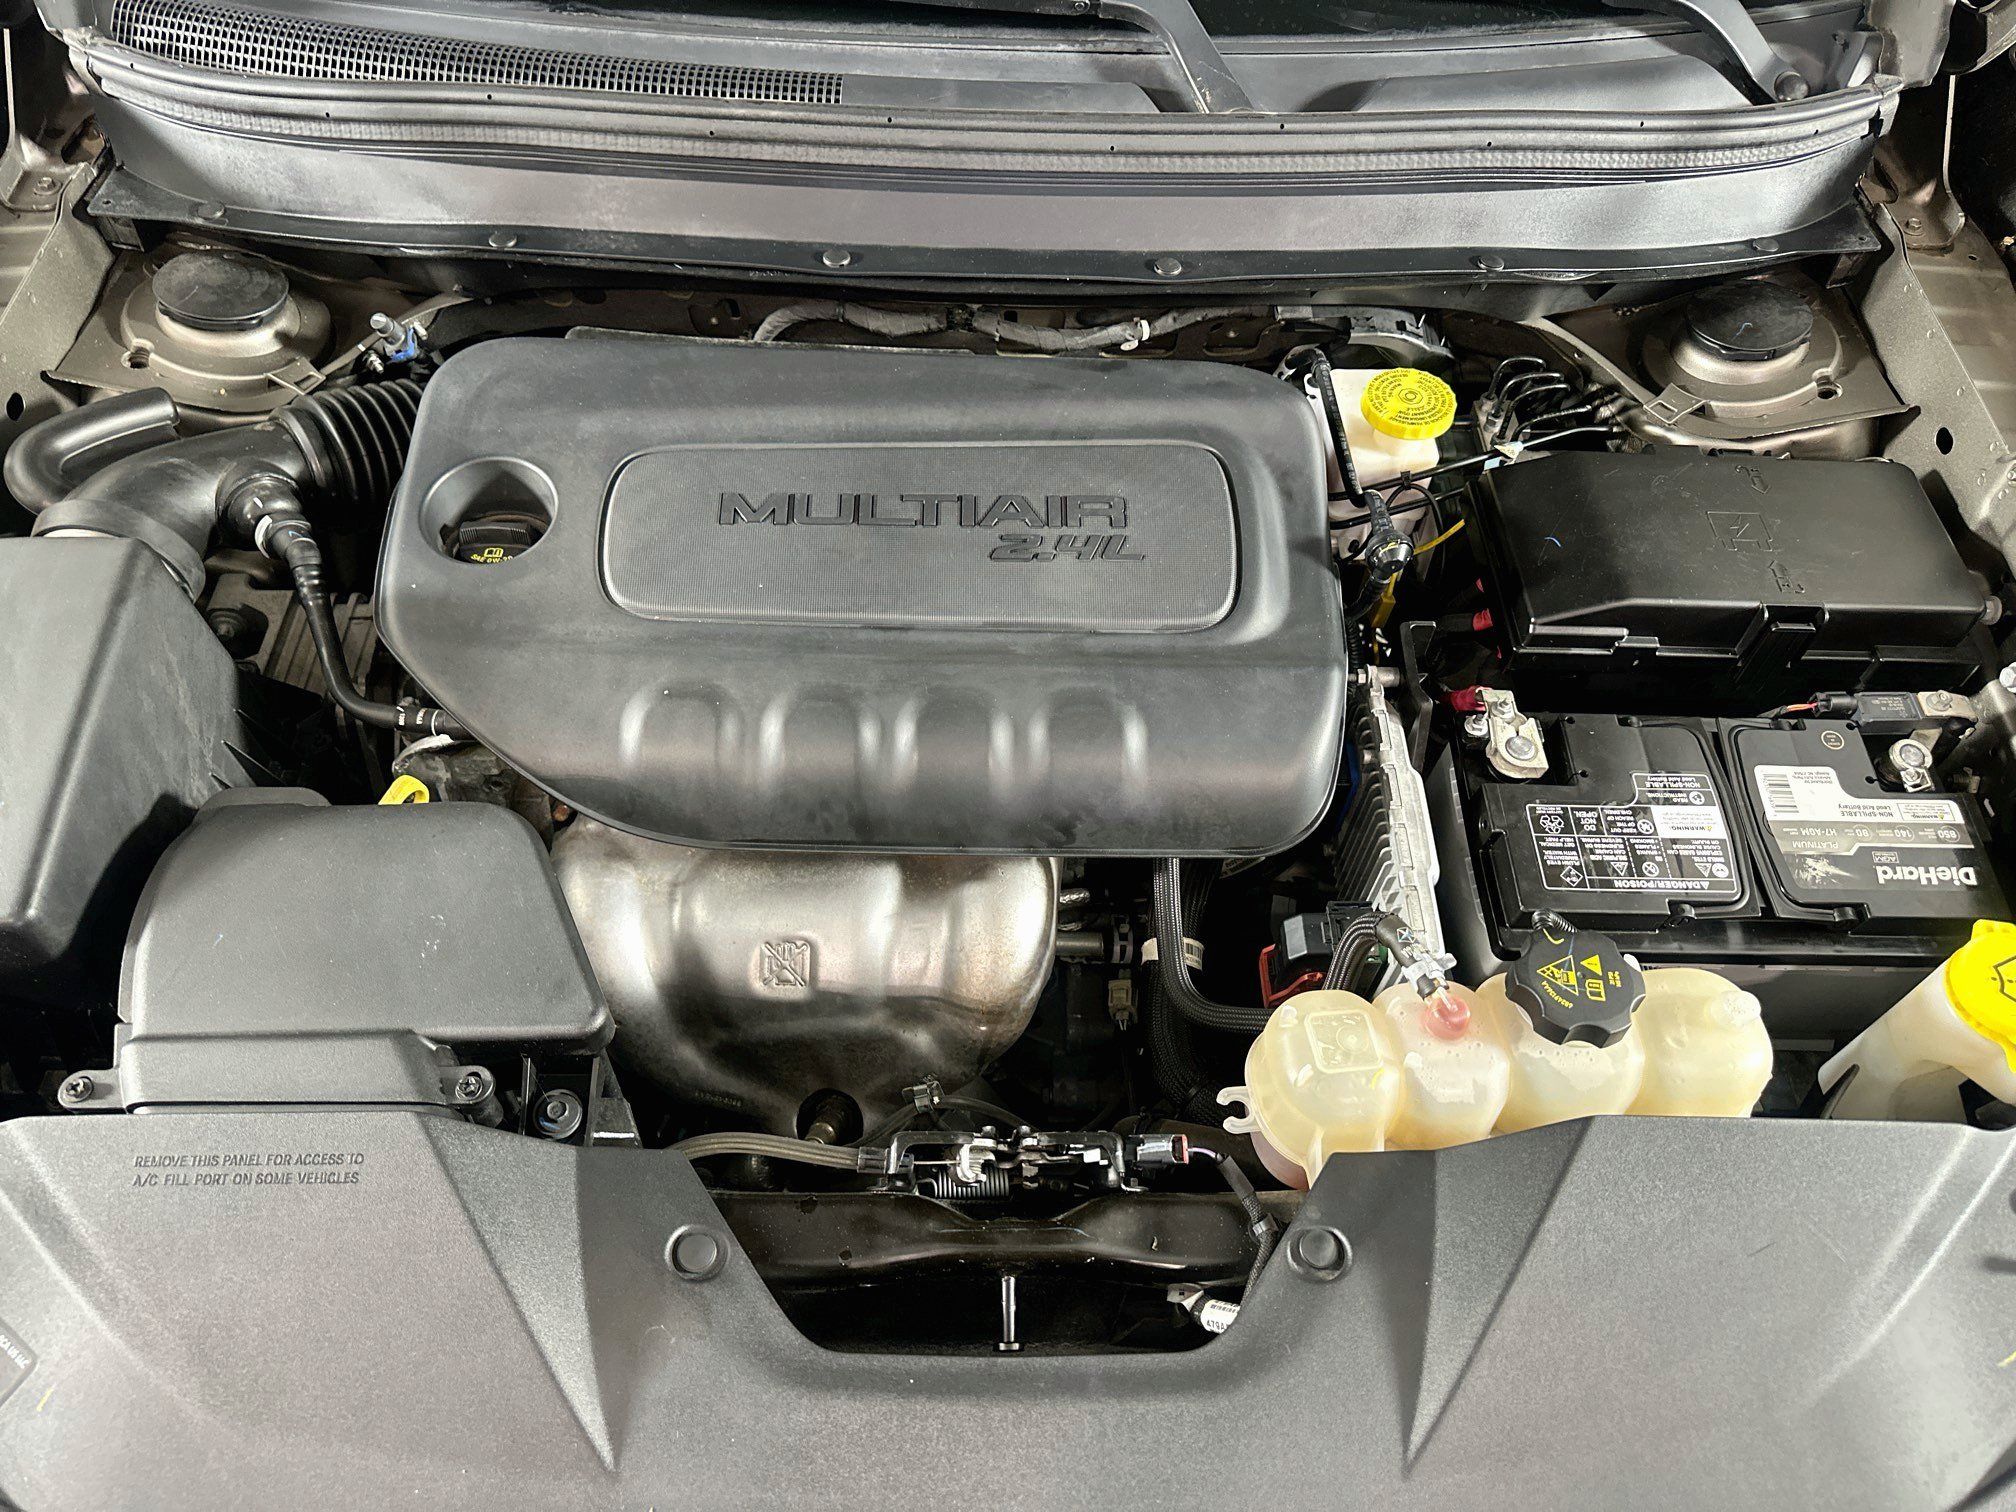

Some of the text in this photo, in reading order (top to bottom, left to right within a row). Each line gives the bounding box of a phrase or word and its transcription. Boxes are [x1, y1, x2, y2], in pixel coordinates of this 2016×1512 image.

[719, 493, 1127, 529] MULTIAIR
[990, 535, 1144, 562] 2.4L
[471, 553, 486, 563] SAE
[1800, 827, 1837, 836] H7-AGM
[1855, 829, 1869, 837] 80
[1893, 829, 1913, 838] 140
[1938, 829, 1958, 839] 850
[1793, 840, 1838, 849] PLATINUM
[1876, 866, 1978, 886] DieHard
[1613, 880, 1701, 889] DANGER/POISON
[134, 1153, 365, 1168] REMOVE THIS PANEL FOR ACCESS TO
[132, 1172, 360, 1187] A/C FILL PORT ON SOME VEHICLES
